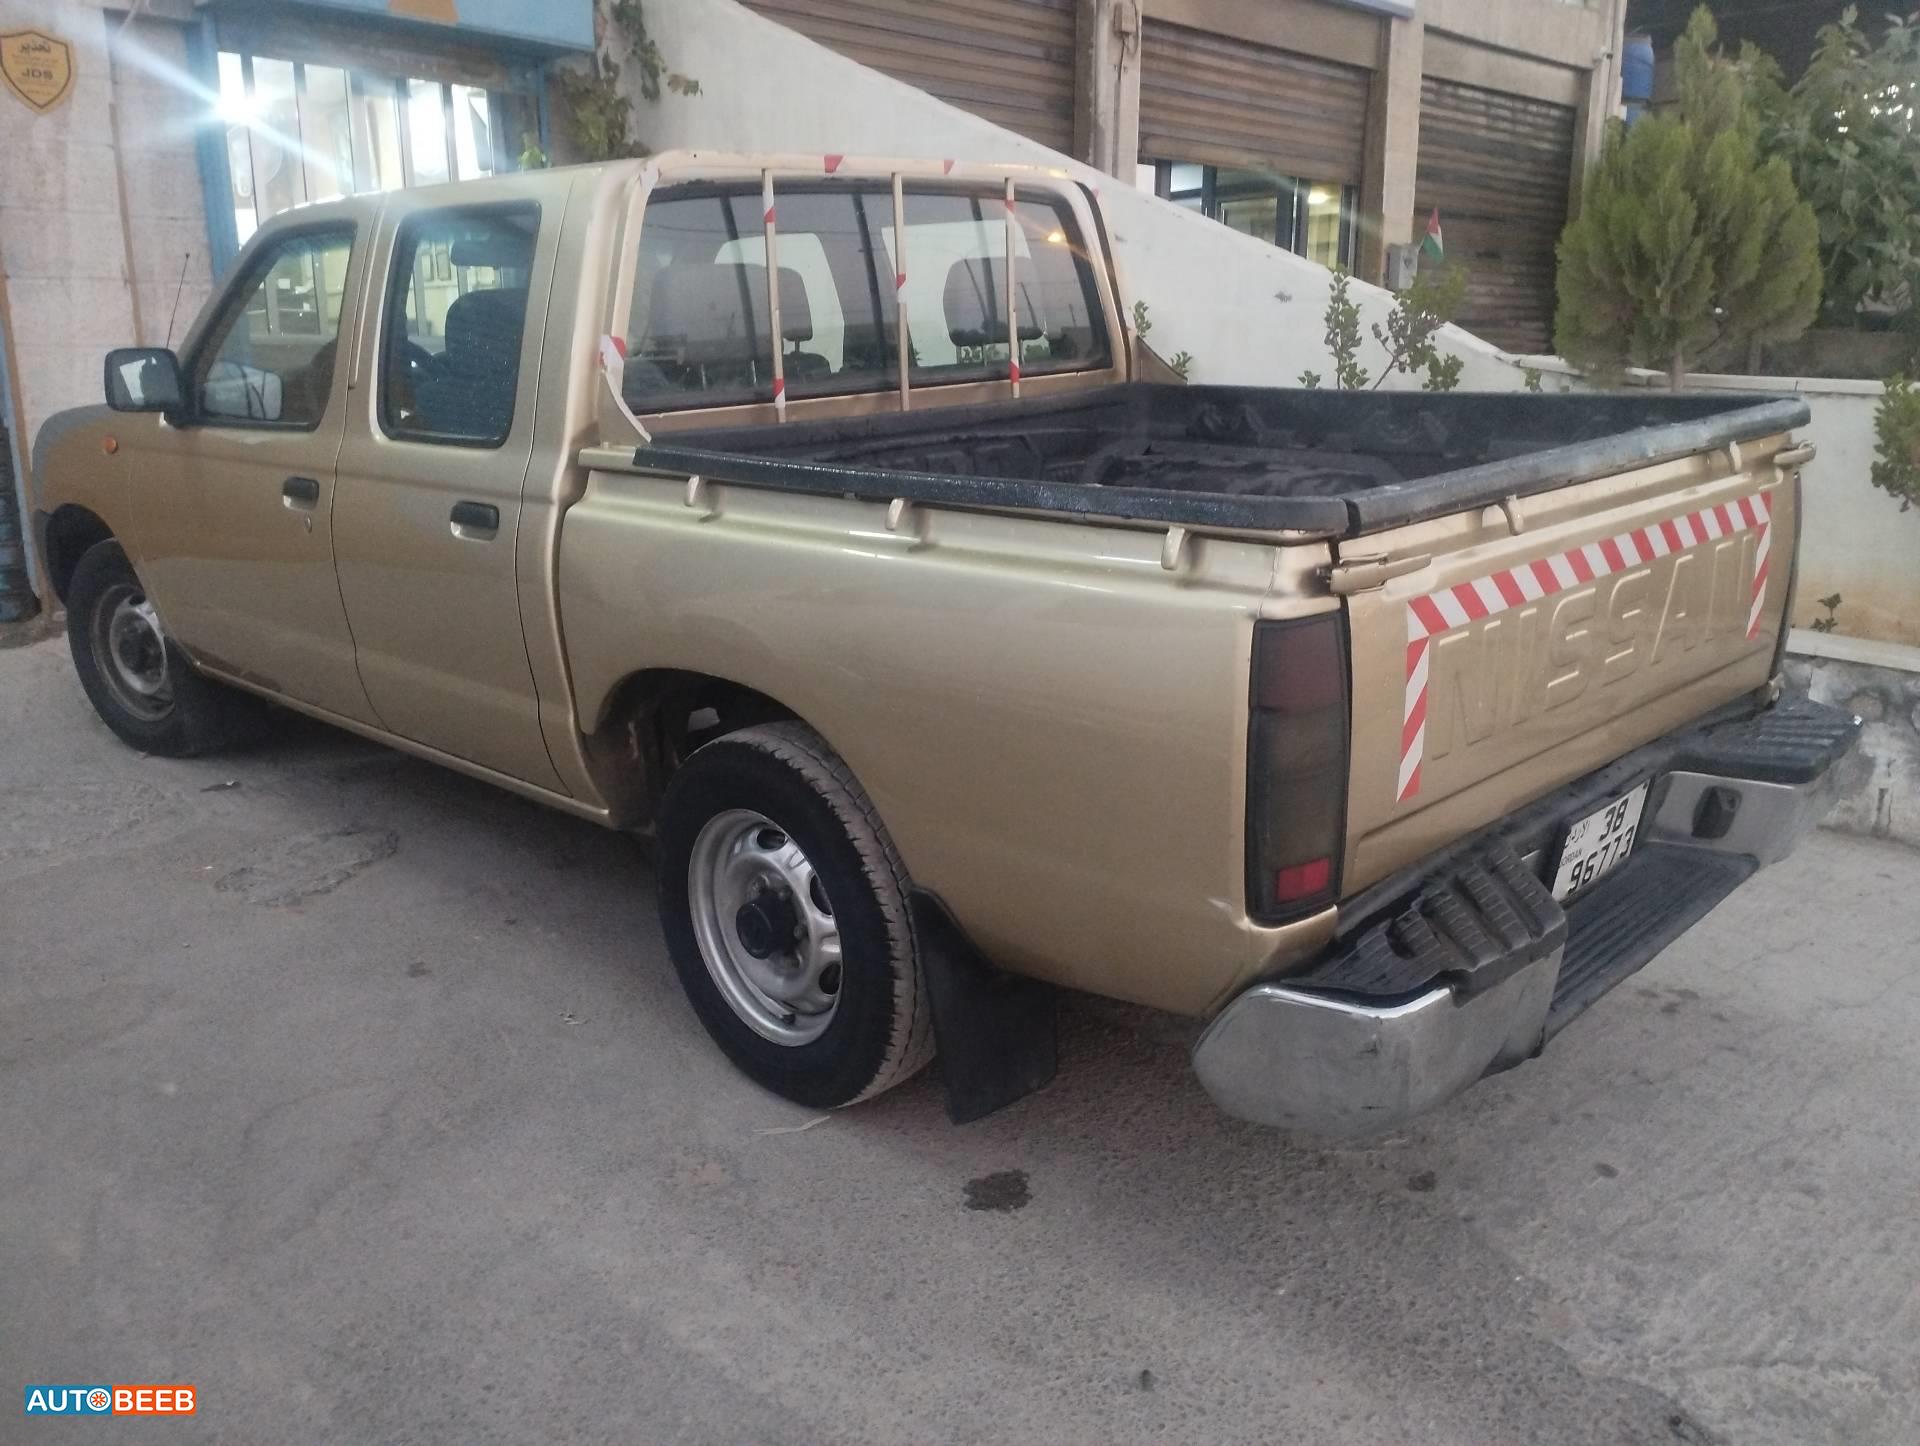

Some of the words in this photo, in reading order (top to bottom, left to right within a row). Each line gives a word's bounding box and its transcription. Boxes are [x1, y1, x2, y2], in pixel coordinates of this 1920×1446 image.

[1432, 533, 1754, 762] NISSAN
[1599, 798, 1629, 841] 38
[1567, 825, 1635, 894] 96773
